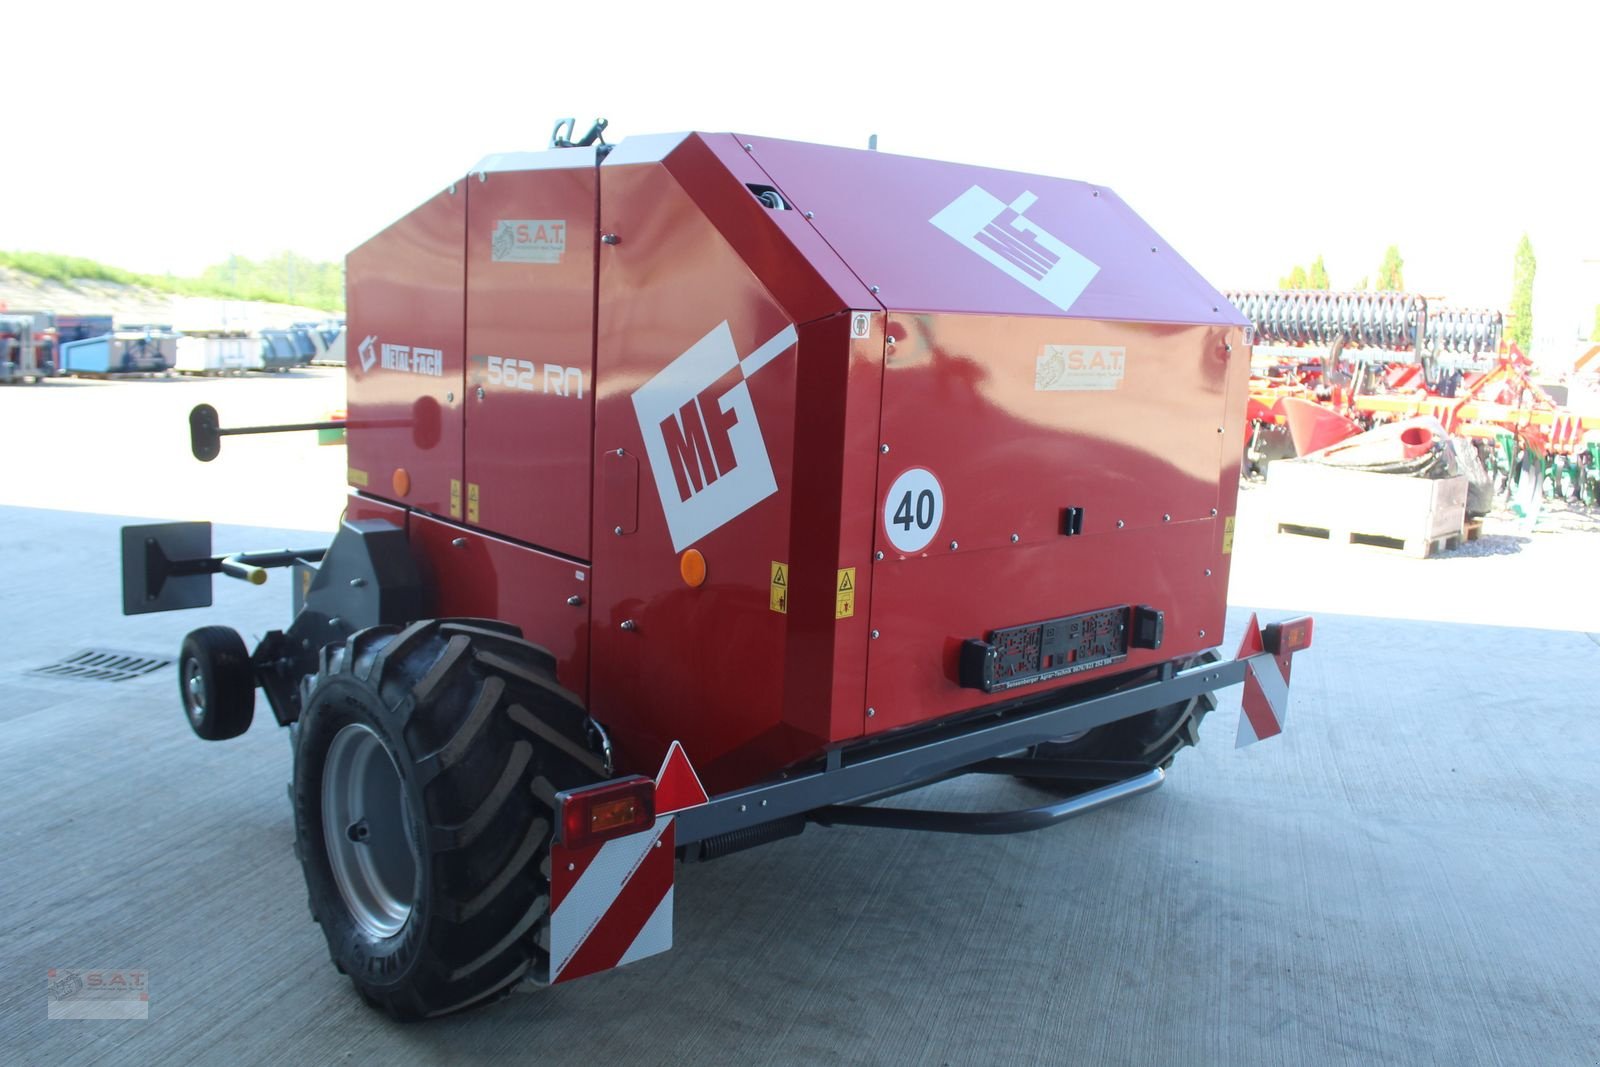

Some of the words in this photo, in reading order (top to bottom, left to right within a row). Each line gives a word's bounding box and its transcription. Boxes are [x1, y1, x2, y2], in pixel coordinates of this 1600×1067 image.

[516, 223, 564, 244] S.A.T.
[973, 206, 1060, 281] MF
[1068, 349, 1122, 370] S.A.T.
[659, 364, 745, 503] MF
[892, 488, 935, 531] 40
